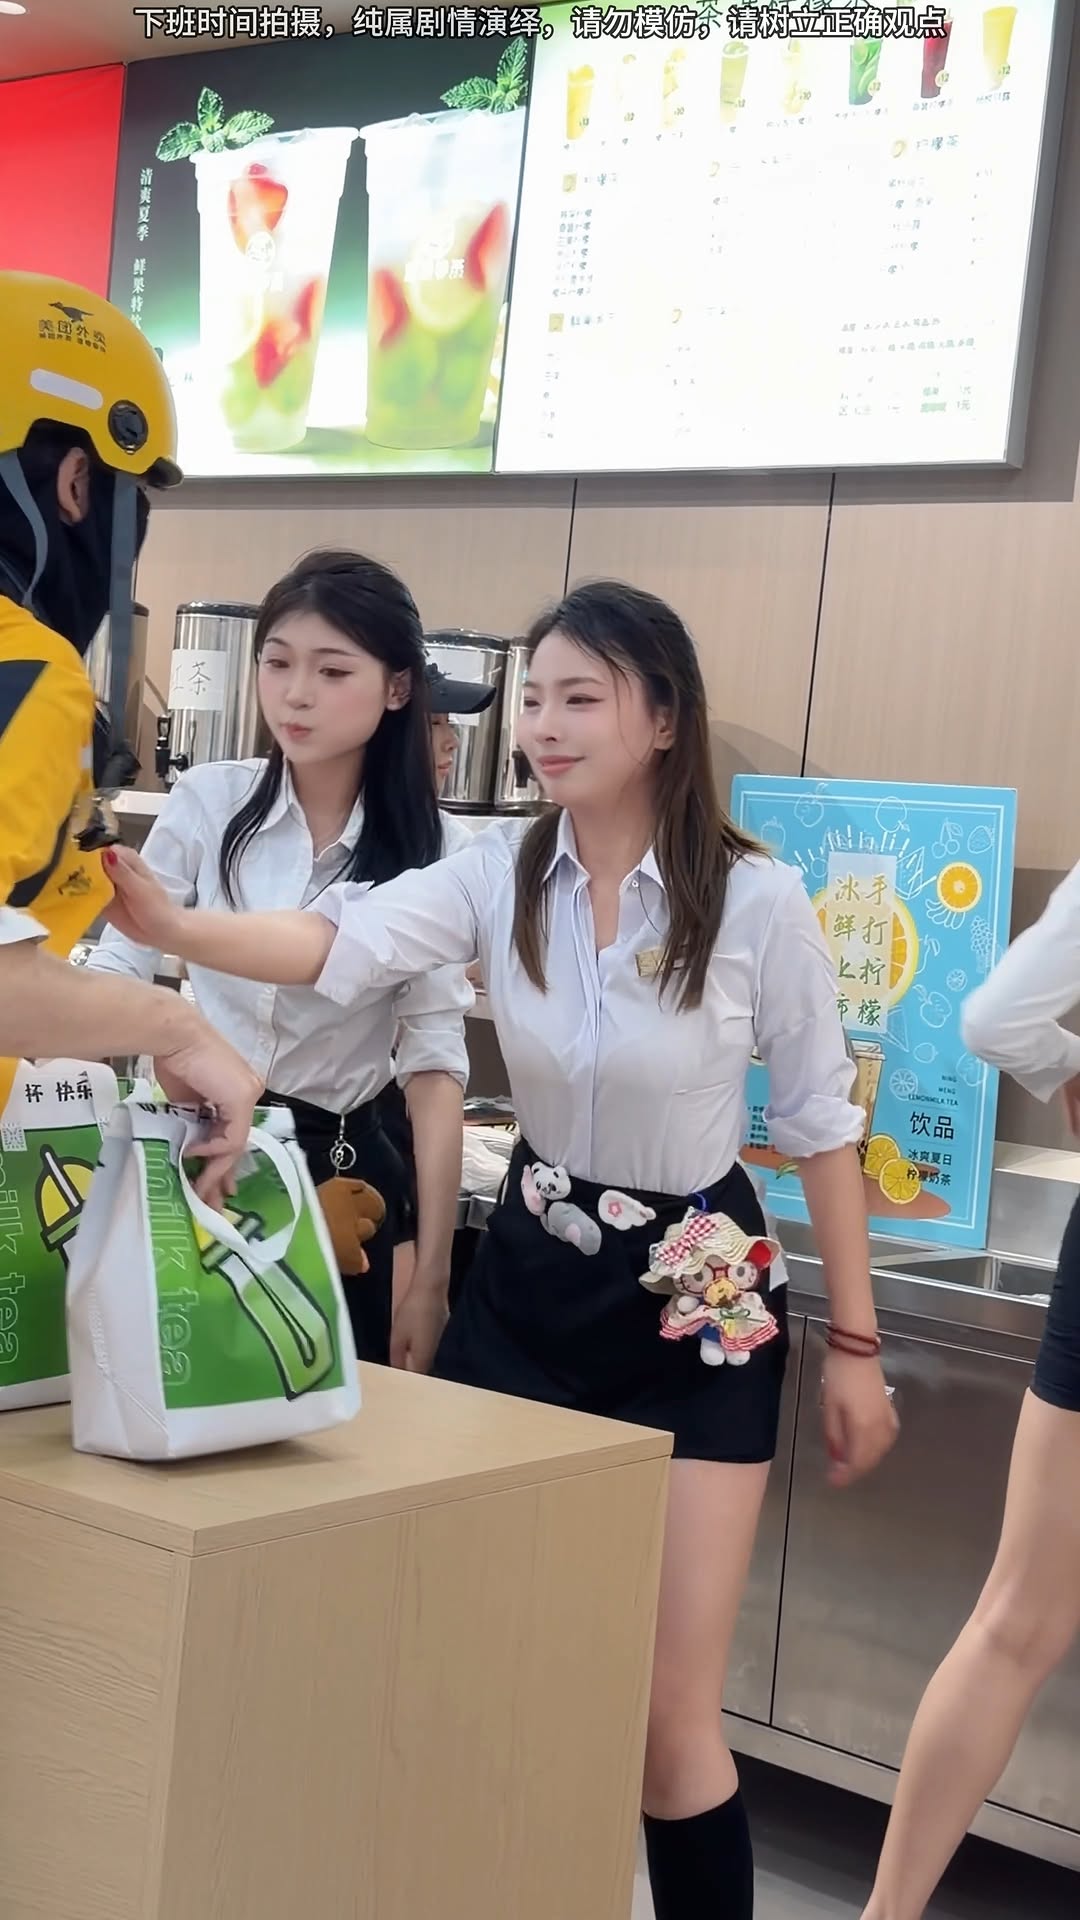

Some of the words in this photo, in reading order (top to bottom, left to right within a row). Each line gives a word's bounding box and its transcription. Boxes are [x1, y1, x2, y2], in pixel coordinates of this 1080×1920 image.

[136, 168, 153, 242] 清爽夏季
[834, 876, 860, 1022] 冰鲜上市
[858, 873, 888, 1027] 手打柠檬
[908, 1149, 953, 1166] 冰爽夏日
[910, 1111, 955, 1139] 饮品
[157, 1286, 200, 1386] tea
